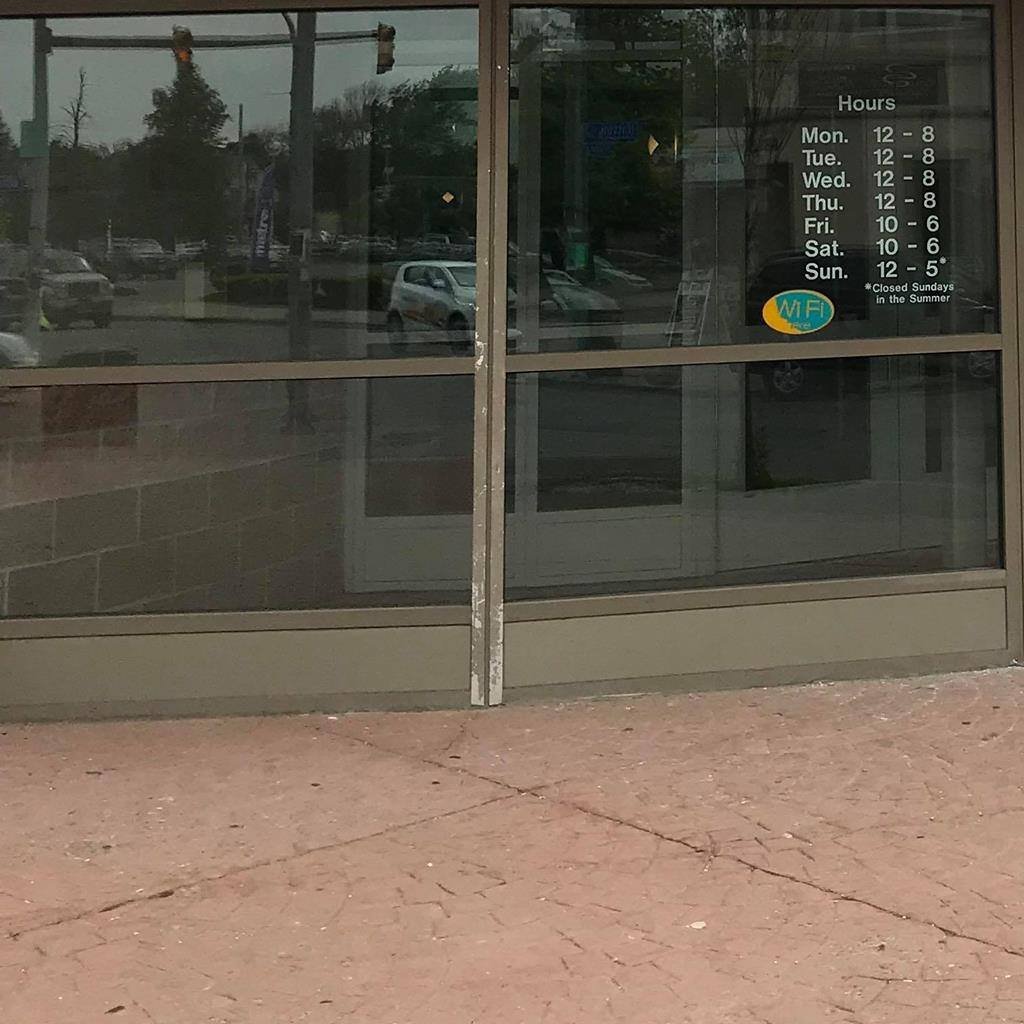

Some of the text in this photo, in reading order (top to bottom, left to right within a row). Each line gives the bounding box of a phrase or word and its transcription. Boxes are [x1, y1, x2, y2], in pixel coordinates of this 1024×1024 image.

[838, 95, 896, 111] Hours
[801, 127, 849, 144] Mon.
[873, 126, 894, 143] 12
[922, 126, 935, 143] 8
[802, 149, 842, 166] Tue.
[873, 148, 894, 165] 12
[922, 148, 935, 165] 8
[802, 172, 851, 188] Wed.
[873, 170, 895, 187] 12
[922, 170, 935, 187] 8
[802, 194, 844, 211] Thu.
[874, 193, 896, 210] 12
[923, 192, 936, 209] 8
[804, 217, 835, 234] Fri.
[876, 216, 898, 233] 10
[926, 215, 939, 233] 6
[804, 240, 844, 257] Sat.
[876, 238, 898, 256] 10
[926, 237, 940, 255] 6
[804, 262, 848, 280] Sun.
[876, 260, 898, 278] 12
[912, 282, 955, 293] Sundays
[876, 293, 951, 304] in the Summer
